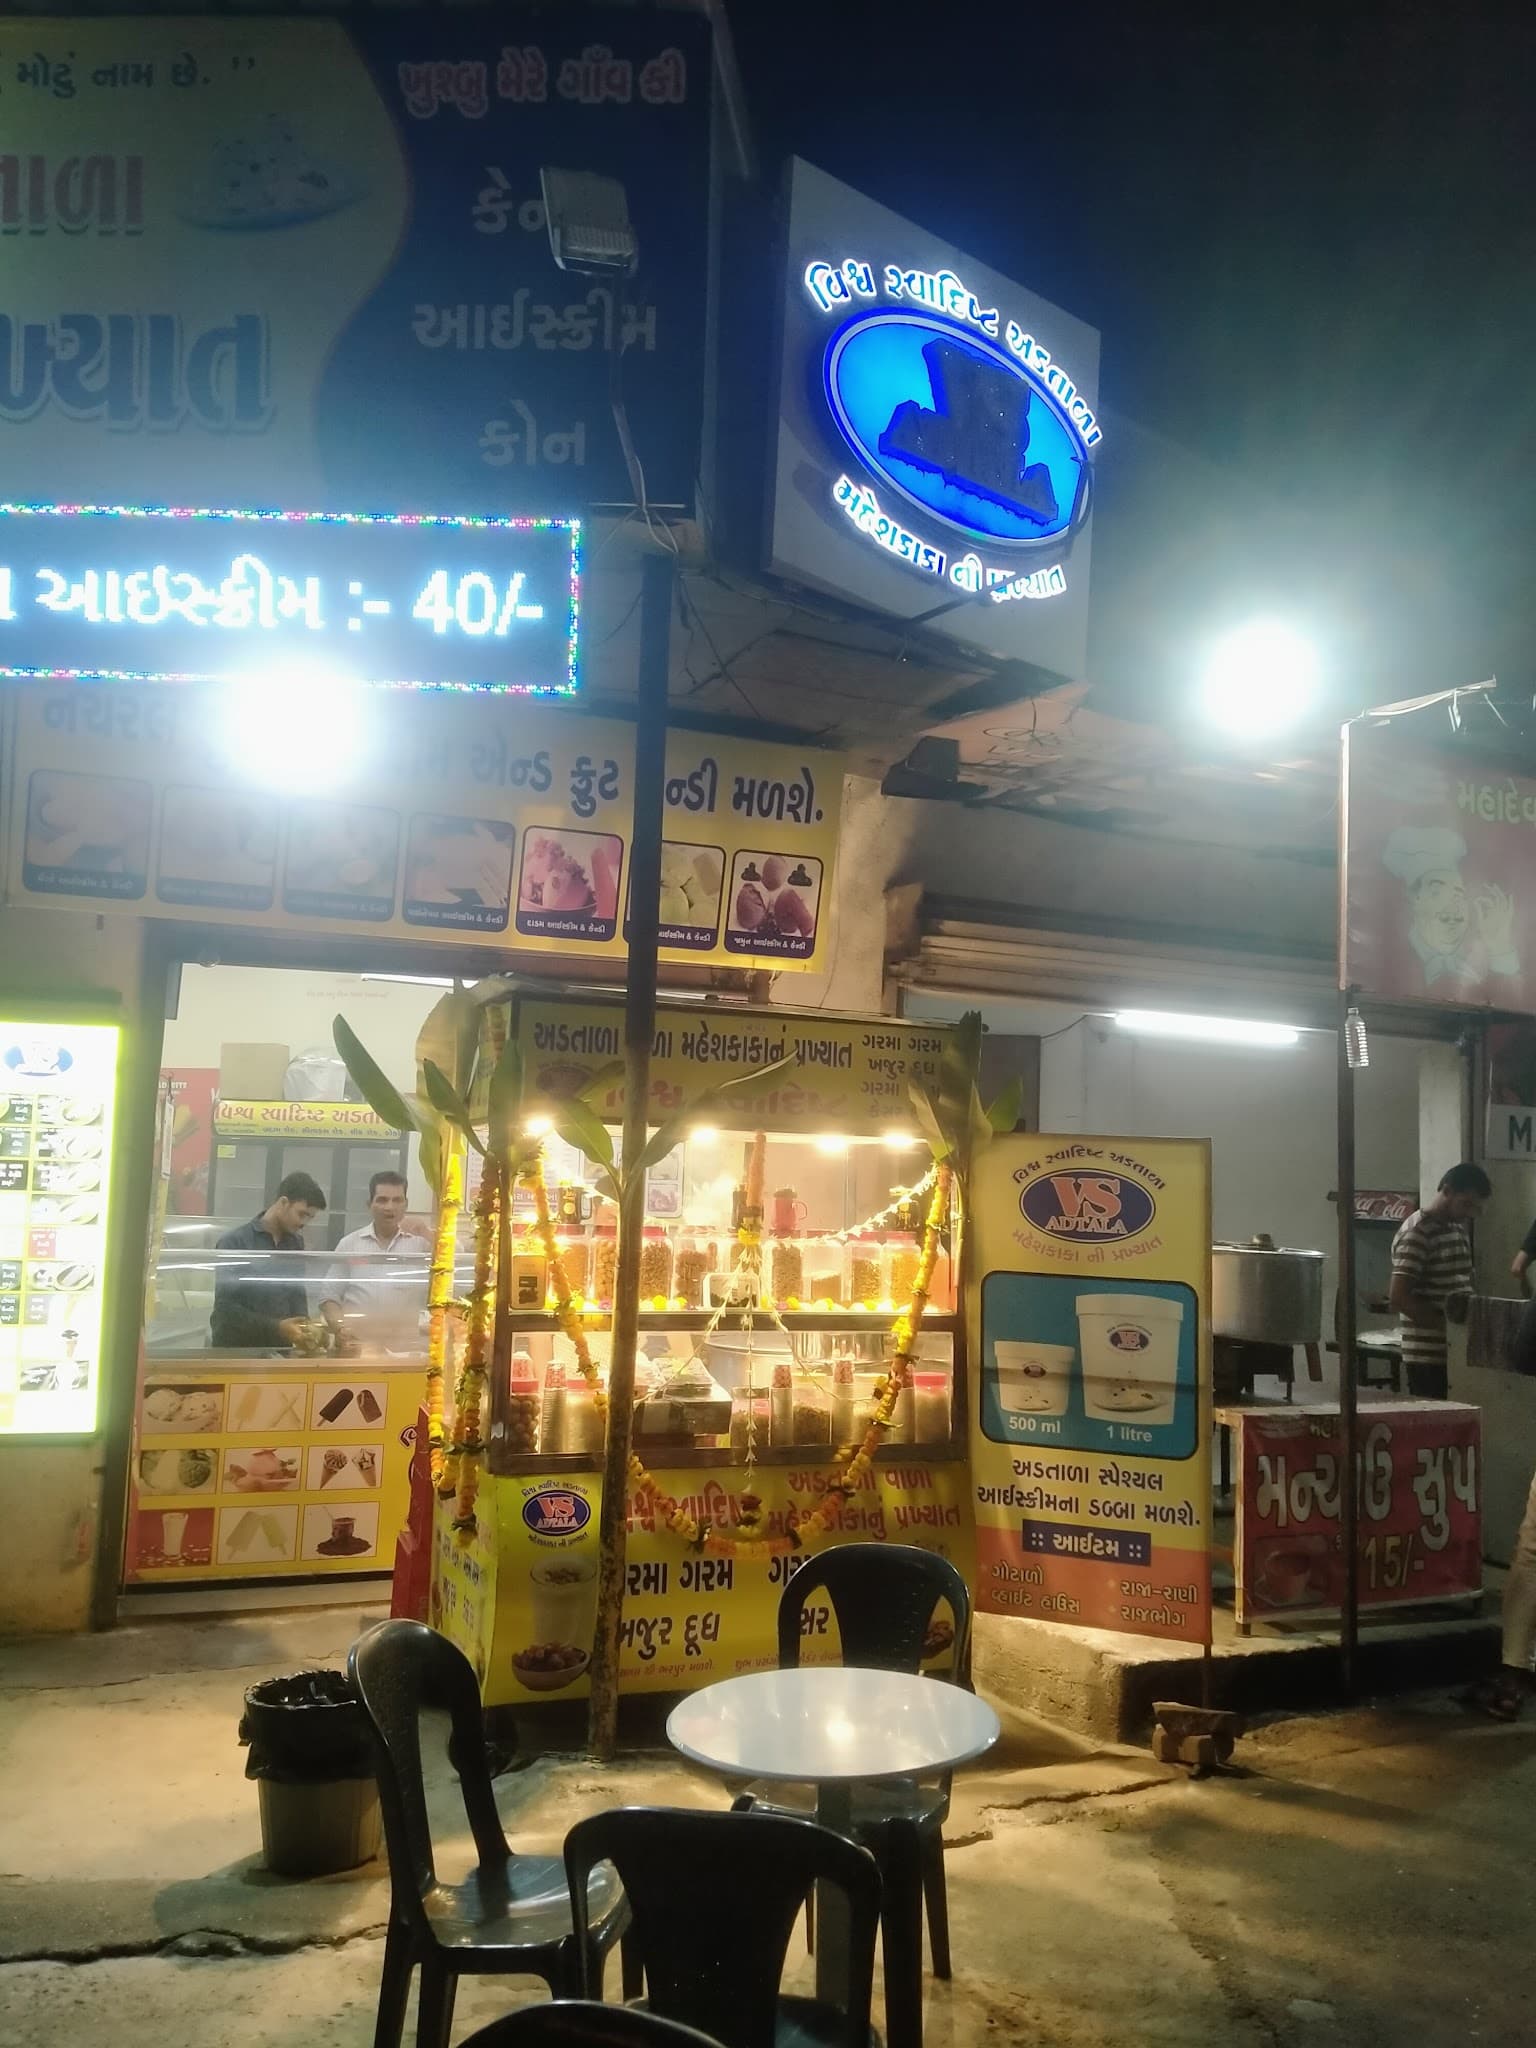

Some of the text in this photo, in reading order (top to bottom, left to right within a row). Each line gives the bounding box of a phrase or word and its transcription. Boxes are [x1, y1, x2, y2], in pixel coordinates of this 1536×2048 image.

[91, 61, 153, 88] નામ
[478, 398, 586, 466] કોન
[413, 569, 544, 635] 40/-
[665, 757, 718, 813] ન્ડી
[534, 1022, 619, 1056] અડતાળા
[1508, 1115, 1536, 1153] M
[1050, 1176, 1122, 1219] VS
[1045, 1215, 1129, 1235] ADTALA
[1009, 1416, 1061, 1434] 500 ml
[1106, 1425, 1153, 1442] 1 litre
[1012, 1459, 1089, 1484] અડતાળા
[536, 1497, 576, 1518] VS
[1145, 1501, 1200, 1527] મળશે.
[1053, 1532, 1119, 1557] આઈટમ
[1364, 1533, 1424, 1589] 15/-
[626, 1561, 668, 1596] રમા
[679, 1558, 733, 1592] ગરમ
[684, 1610, 721, 1657] દૂધ
